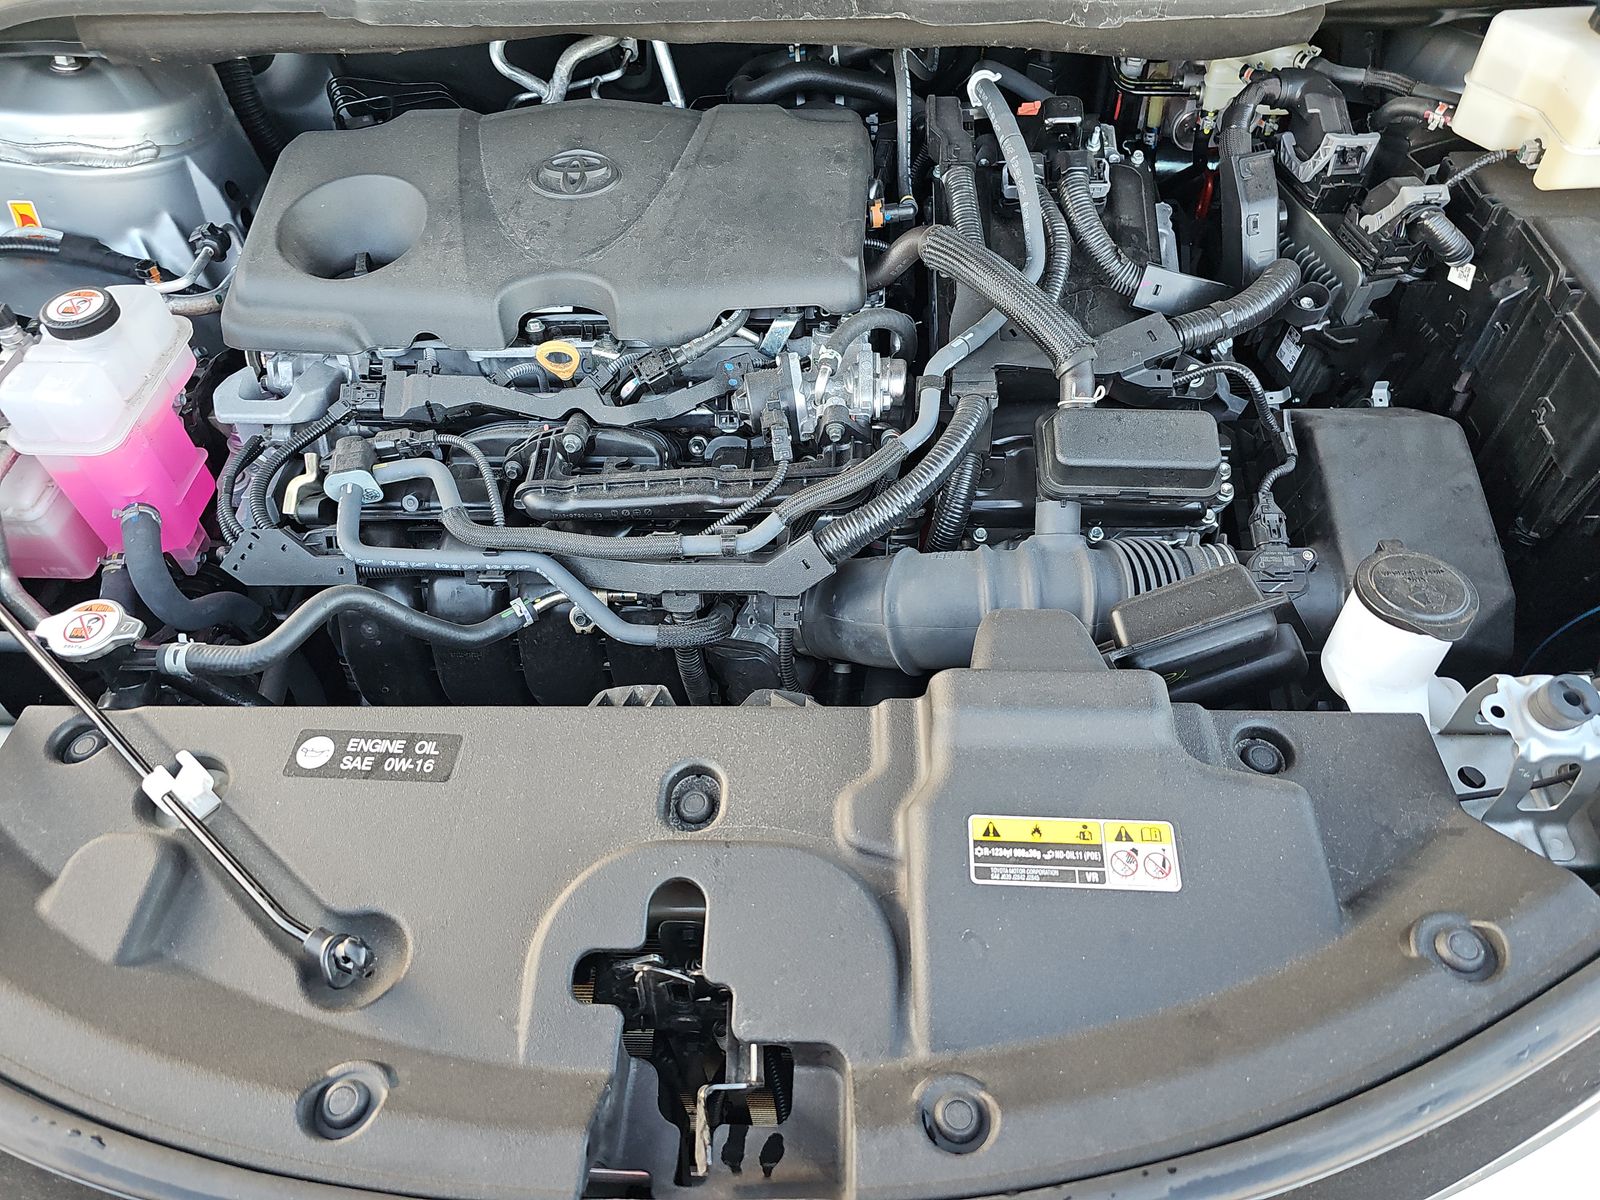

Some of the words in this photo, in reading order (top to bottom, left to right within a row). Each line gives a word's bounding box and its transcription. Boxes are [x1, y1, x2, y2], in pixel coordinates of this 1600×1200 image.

[346, 738, 406, 753] ENGINE
[414, 740, 440, 755] OIL
[339, 756, 375, 771] SAE
[383, 758, 435, 773] 0W-16
[1084, 851, 1101, 862] (POE)
[1085, 871, 1099, 883] VR
